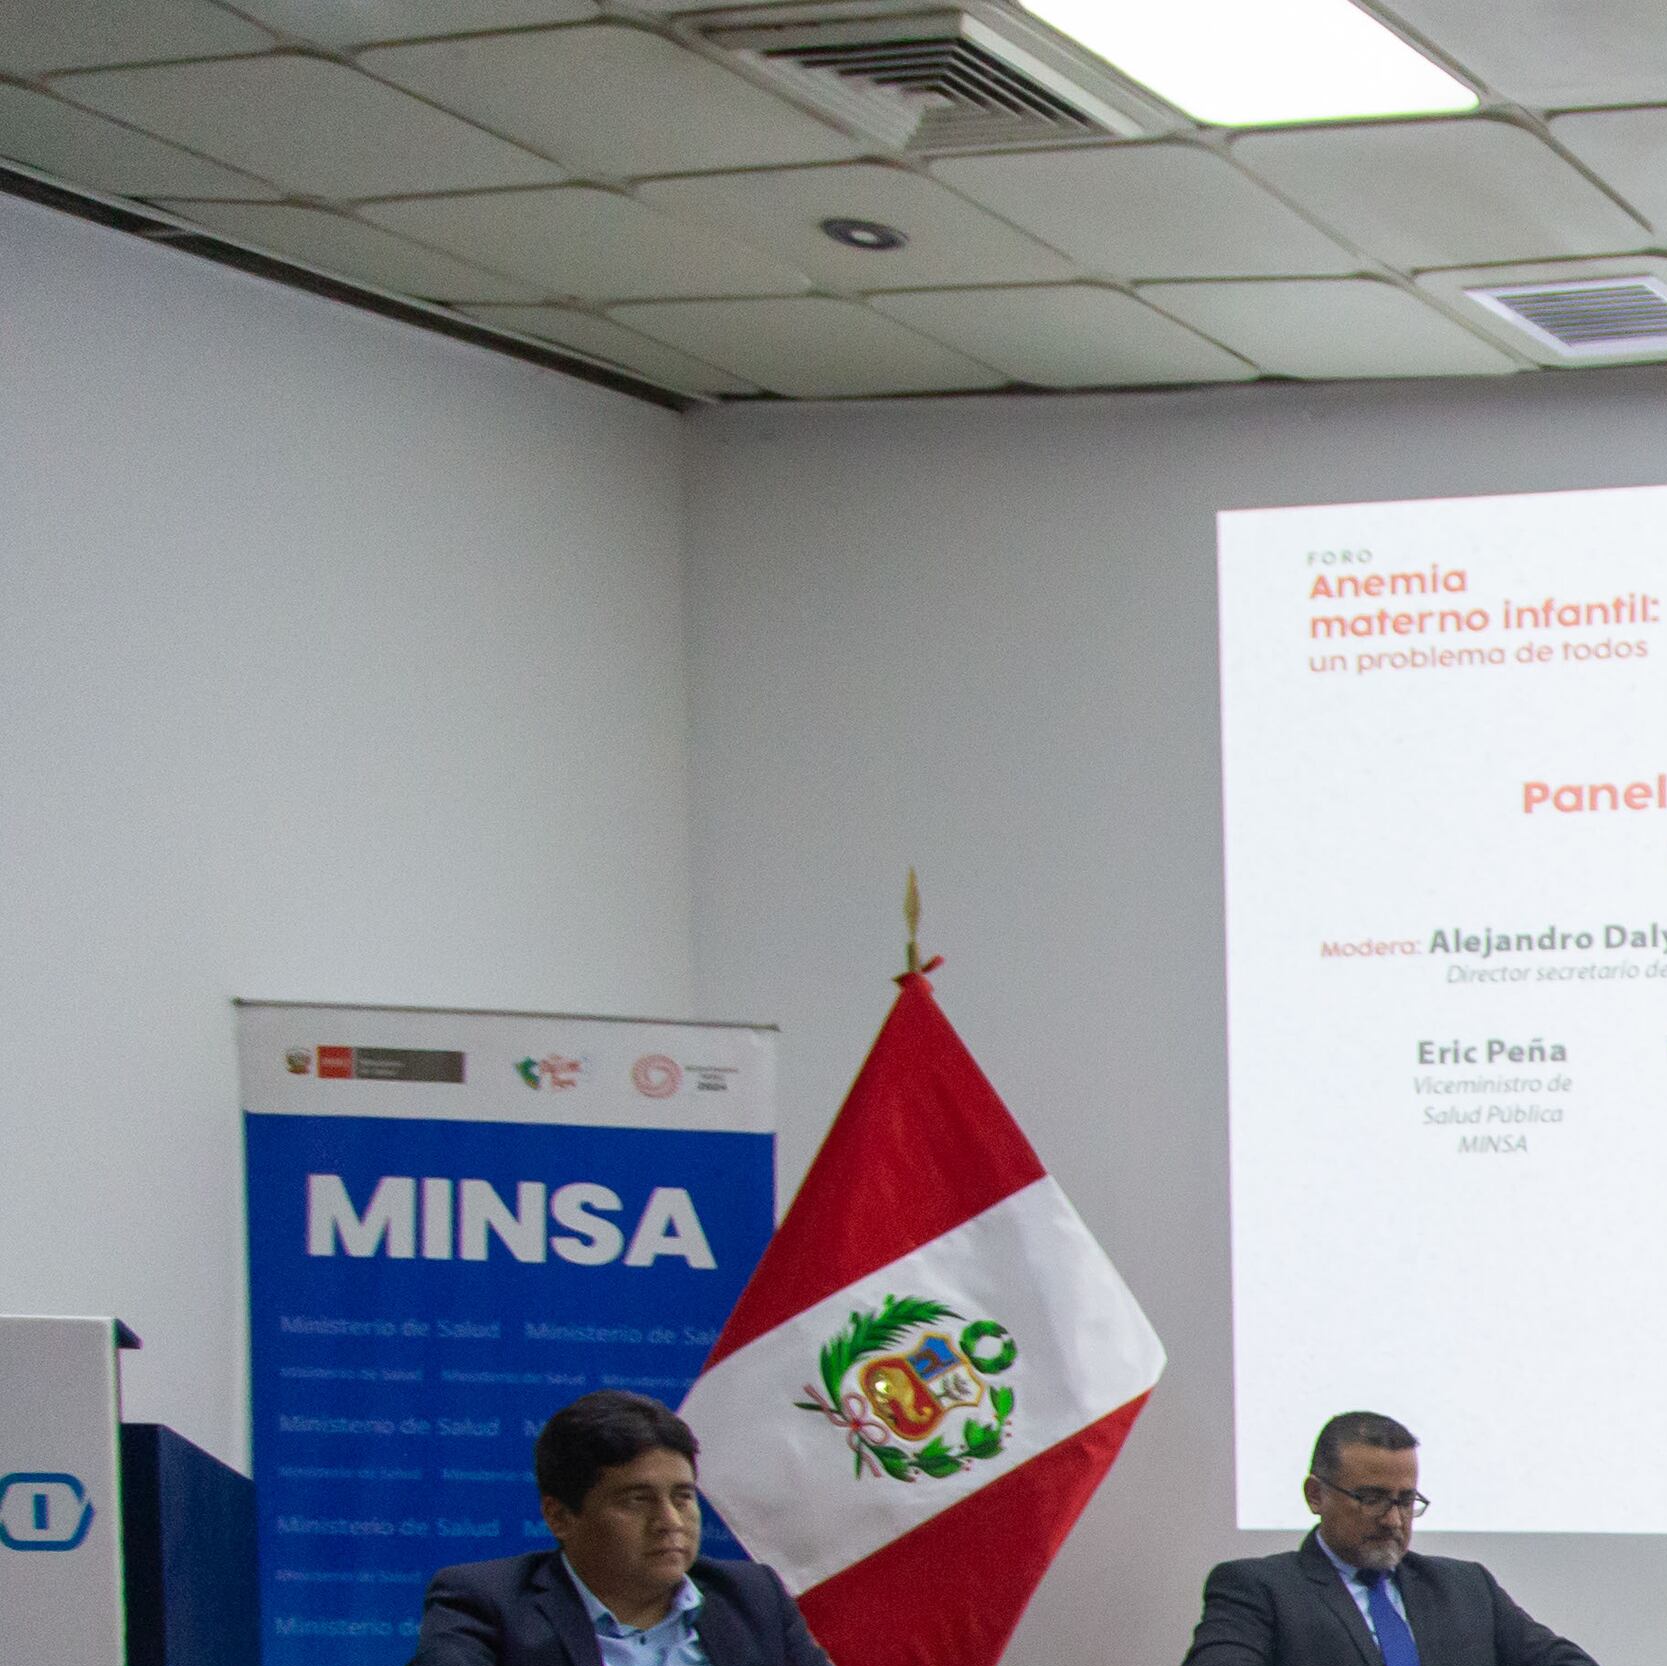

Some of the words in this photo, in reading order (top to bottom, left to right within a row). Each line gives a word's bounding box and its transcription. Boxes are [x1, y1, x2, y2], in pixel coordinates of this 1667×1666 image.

[1305, 548, 1373, 567] FORO
[1309, 563, 1466, 599] Anemia
[1310, 608, 1489, 639] materno
[1503, 593, 1659, 629] infantil:
[1308, 655, 1347, 673] un
[1356, 646, 1505, 675] problema
[1514, 641, 1554, 664] de
[1561, 638, 1648, 661] todos
[1320, 939, 1421, 959] Modera:
[1429, 926, 1594, 959] Alejandro
[1446, 964, 1531, 984] Director
[1536, 960, 1640, 982] secretario
[1417, 1040, 1477, 1065] Eric
[1486, 1038, 1567, 1063] Peña
[1413, 1075, 1543, 1095] Viceministro
[1548, 1073, 1572, 1092] de
[1423, 1106, 1482, 1125] Salud
[1486, 1104, 1563, 1124] Pública
[1457, 1134, 1528, 1153] MINSA
[308, 1174, 717, 1270] MINSA
[280, 1315, 397, 1337] Ministerio
[437, 1319, 501, 1340] Salud
[524, 1321, 643, 1344] Ministerio
[683, 1326, 722, 1347] Sal
[280, 1414, 396, 1434] Ministerio
[437, 1417, 501, 1438] Salud
